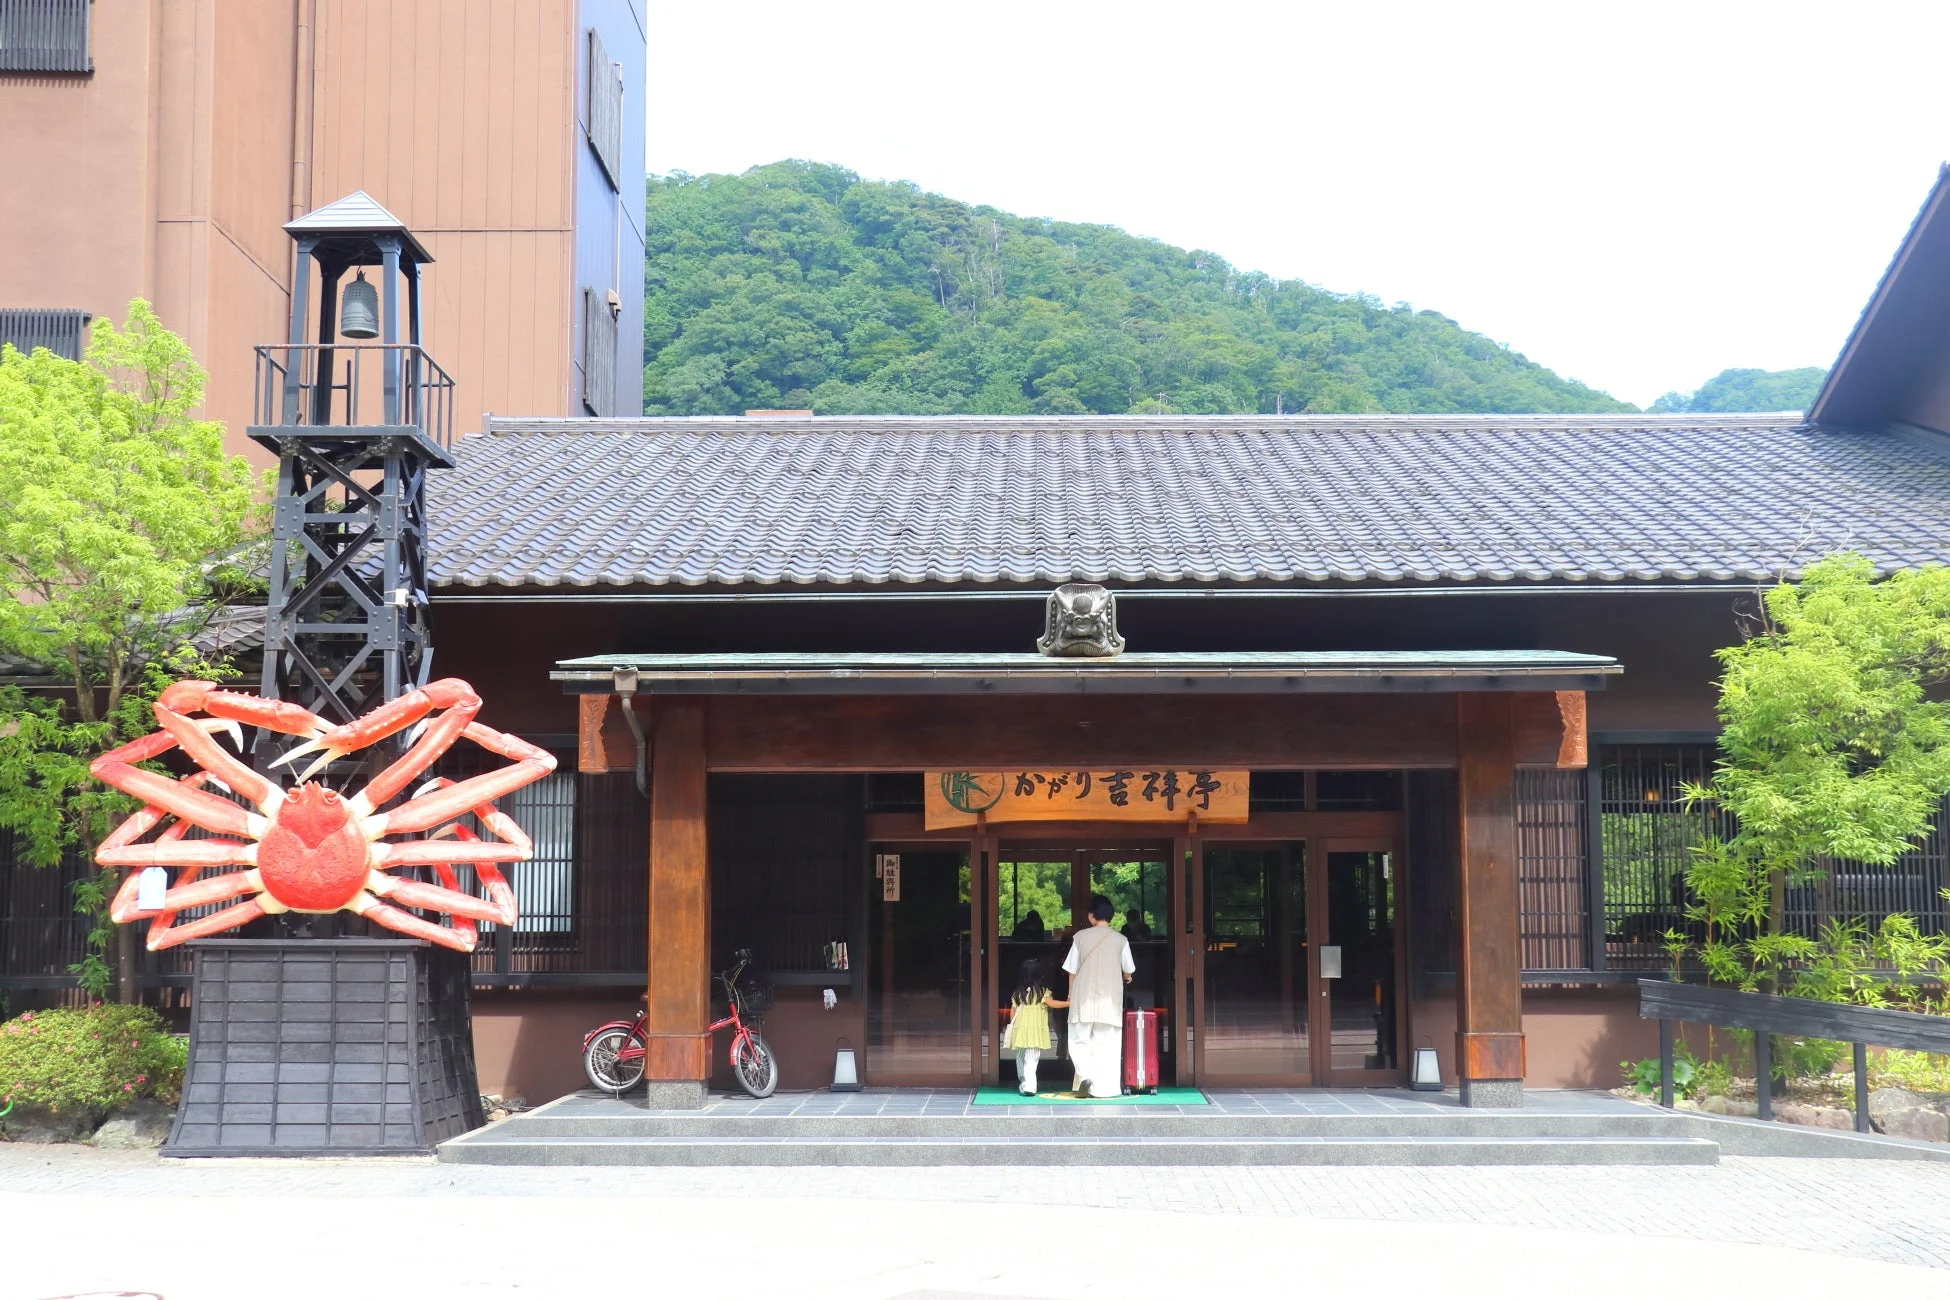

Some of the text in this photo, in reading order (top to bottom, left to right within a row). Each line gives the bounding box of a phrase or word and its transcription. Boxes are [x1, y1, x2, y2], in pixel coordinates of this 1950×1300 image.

[1014, 771, 1221, 811] かがり吉祥亭
